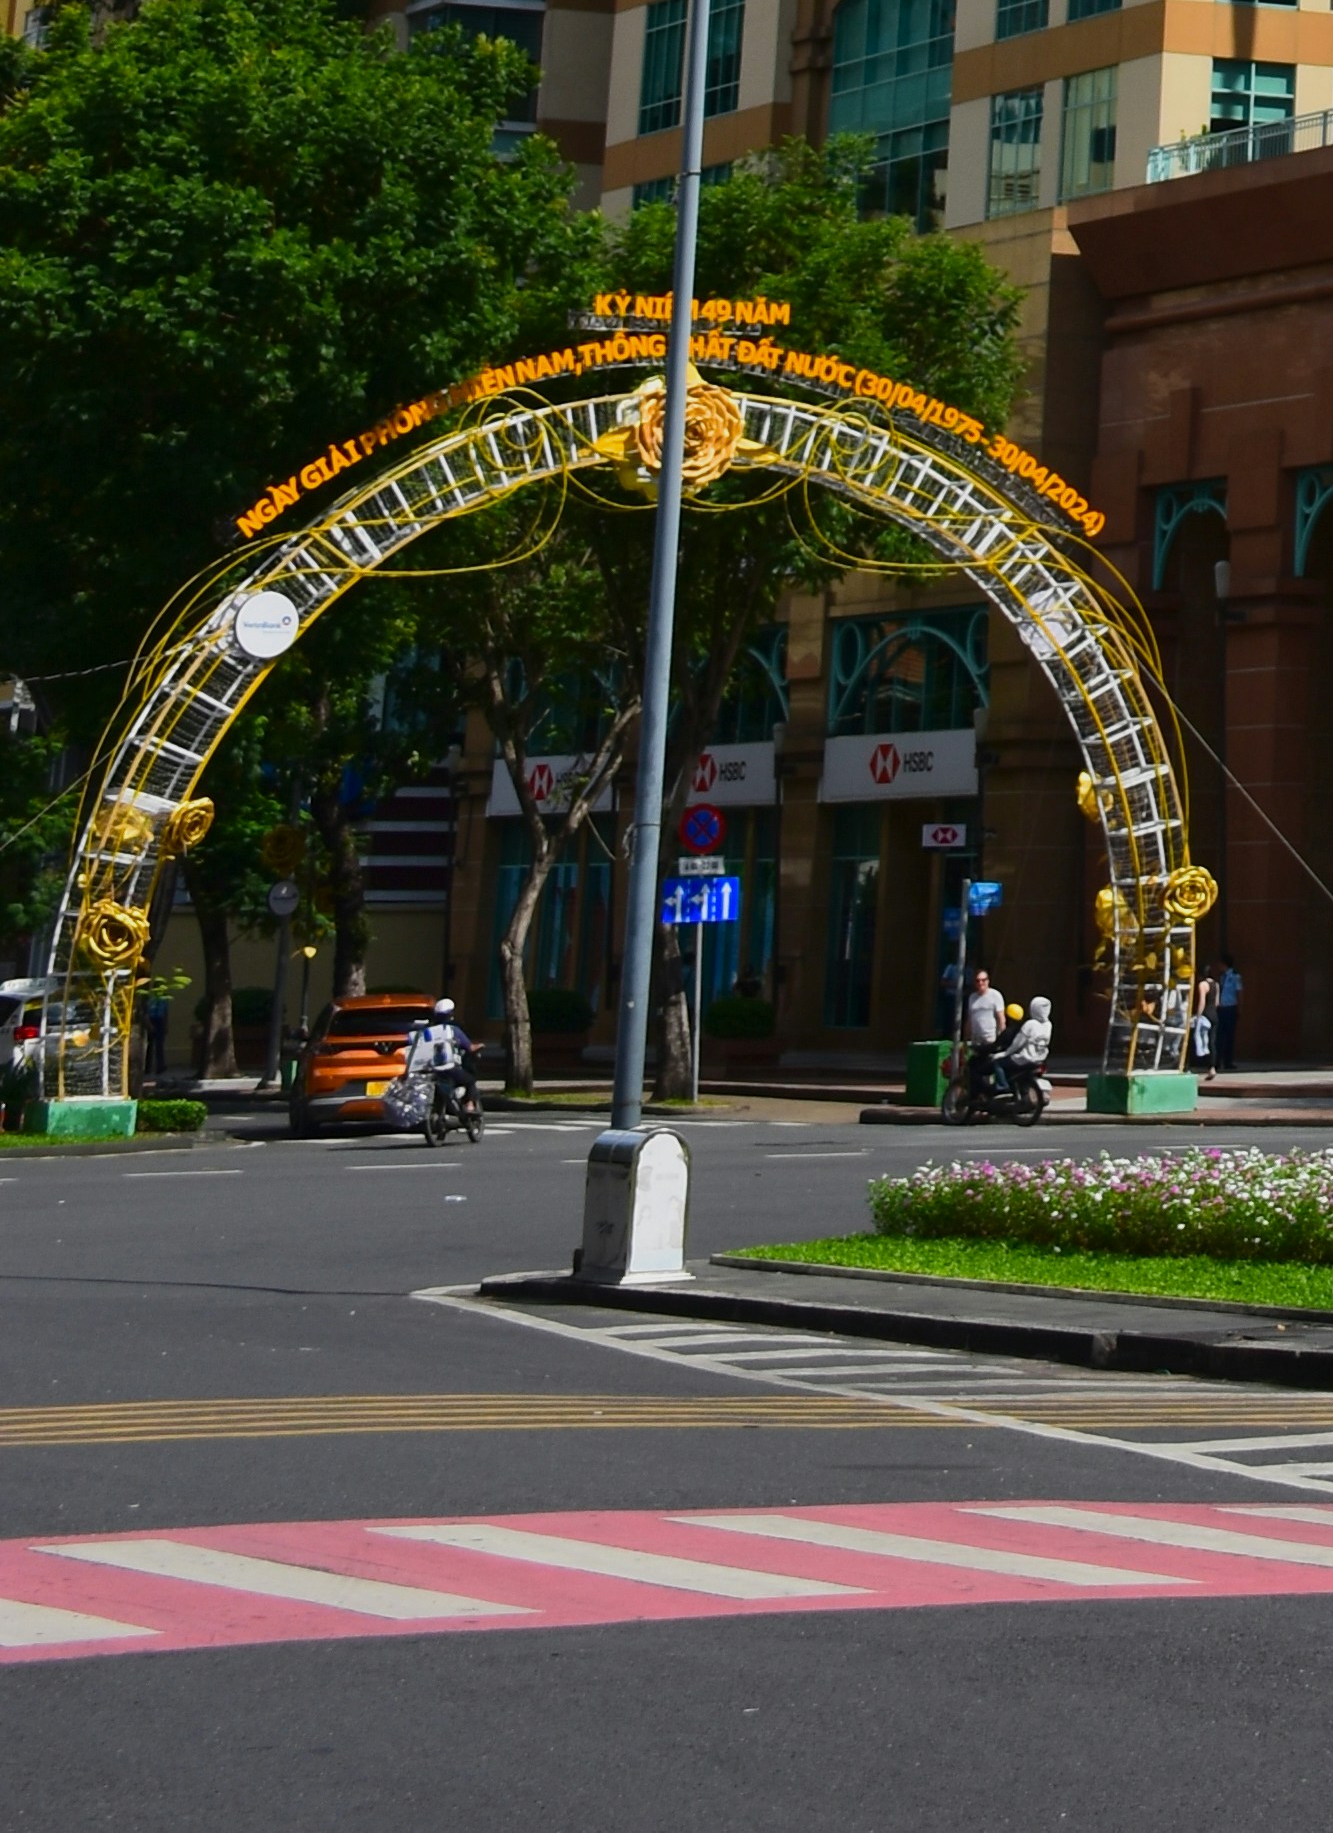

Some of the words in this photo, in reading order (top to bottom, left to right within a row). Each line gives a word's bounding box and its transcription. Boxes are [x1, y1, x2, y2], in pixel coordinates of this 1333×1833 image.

[594, 288, 631, 316] KỶ
[634, 291, 700, 322] NI
[701, 299, 732, 323] 49
[735, 295, 790, 325] NĂM
[235, 476, 301, 538] NGÀY
[300, 438, 362, 490] GIẢI
[359, 391, 447, 456] PHÓN
[689, 326, 735, 361] HẤT
[735, 336, 784, 370] ĐẤT
[783, 350, 856, 388] NƯỚC
[719, 762, 747, 781] HSBC
[903, 751, 934, 772] HSBC
